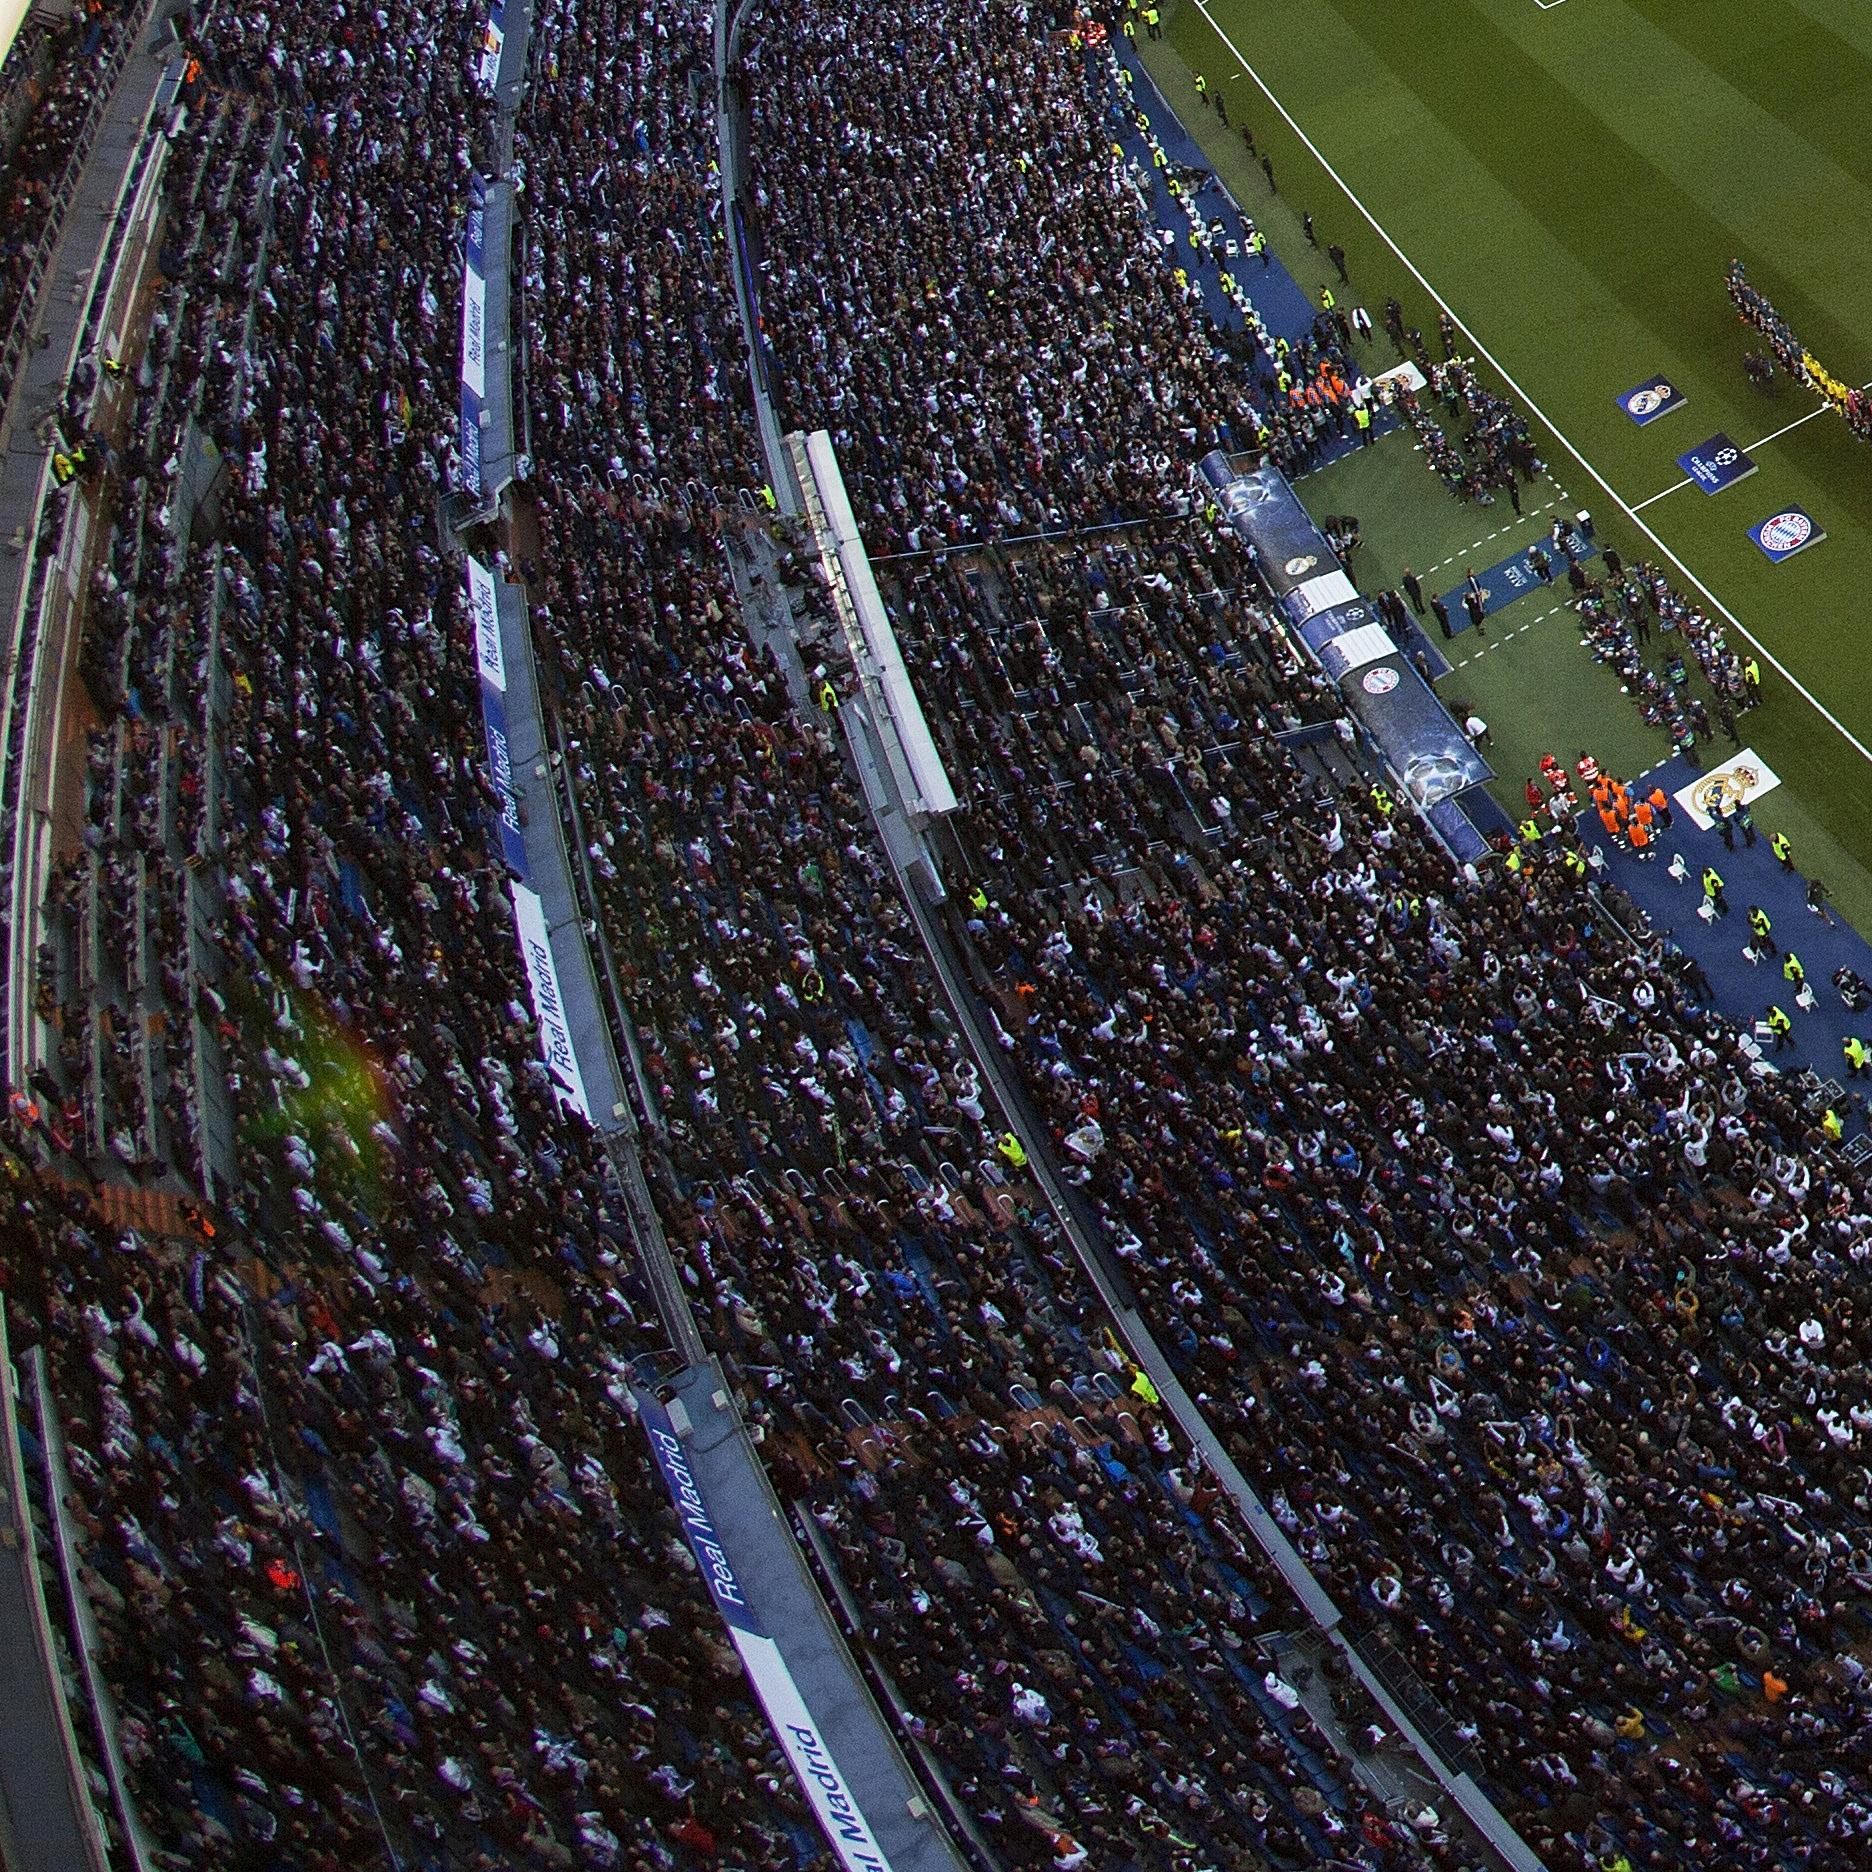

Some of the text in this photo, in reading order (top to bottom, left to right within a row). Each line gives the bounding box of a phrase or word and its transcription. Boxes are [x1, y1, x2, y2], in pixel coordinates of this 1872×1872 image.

[1690, 455, 1720, 485] CHAMPIONS
[527, 938, 575, 1073] Real Madrid
[651, 1428, 746, 1606] Real Madrid
[786, 1724, 874, 1844] Madrid
